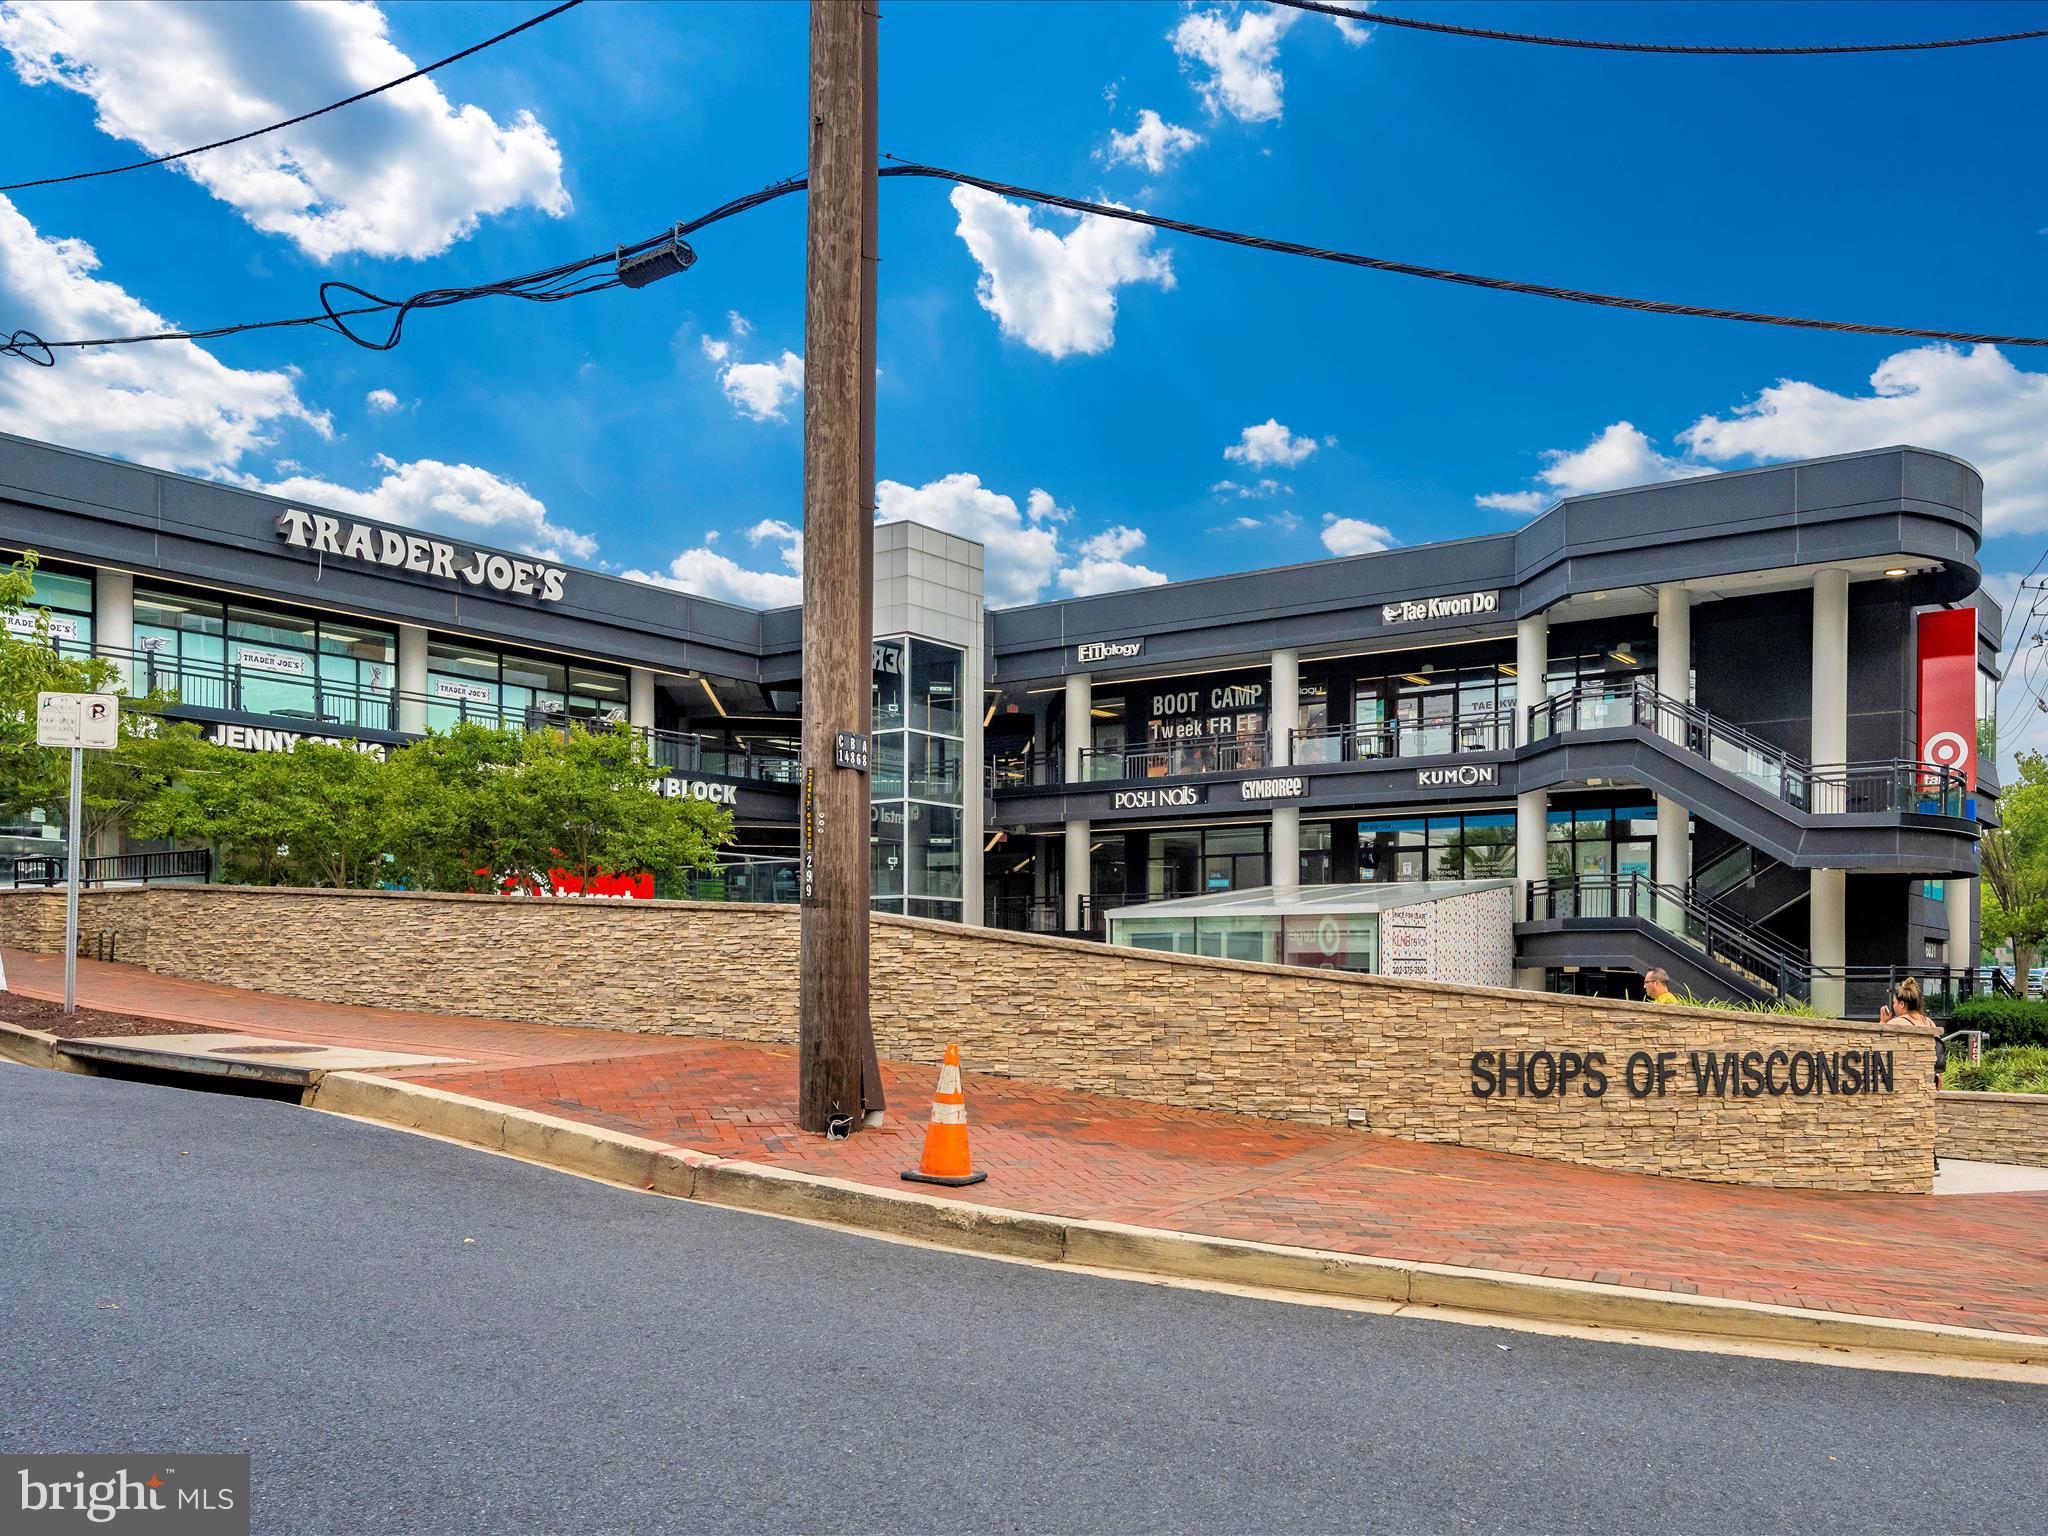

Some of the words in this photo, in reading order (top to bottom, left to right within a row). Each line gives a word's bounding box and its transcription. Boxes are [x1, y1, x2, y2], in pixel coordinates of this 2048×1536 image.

[282, 509, 457, 579] TRADER
[460, 552, 567, 601] JOE'S
[1400, 601, 1427, 620] Tae
[1428, 597, 1471, 618] Kwon
[1473, 592, 1496, 612] Do
[7, 617, 34, 628] RADE
[50, 624, 71, 633] OE'S
[243, 654, 275, 666] TRADER
[277, 659, 300, 669] JOE'S
[1078, 641, 1141, 662] FITology
[440, 685, 468, 696] TRADER
[468, 689, 488, 699] JOE'S
[1153, 691, 1199, 716] BOOT
[1211, 684, 1262, 709] CAMP
[1472, 701, 1492, 711] TAE
[1499, 699, 1518, 708] KW
[1162, 720, 1203, 739] week
[1209, 713, 1257, 735] FREE
[208, 725, 301, 753] JENNY
[838, 749, 868, 767] 14868
[1419, 766, 1492, 785] KUMON
[665, 777, 739, 804] BLOCK
[1115, 792, 1156, 809] POSH
[1471, 1050, 1608, 1098] SHOPS
[1626, 1050, 1677, 1098] OF
[1691, 1049, 1894, 1097] WISCONSIN
